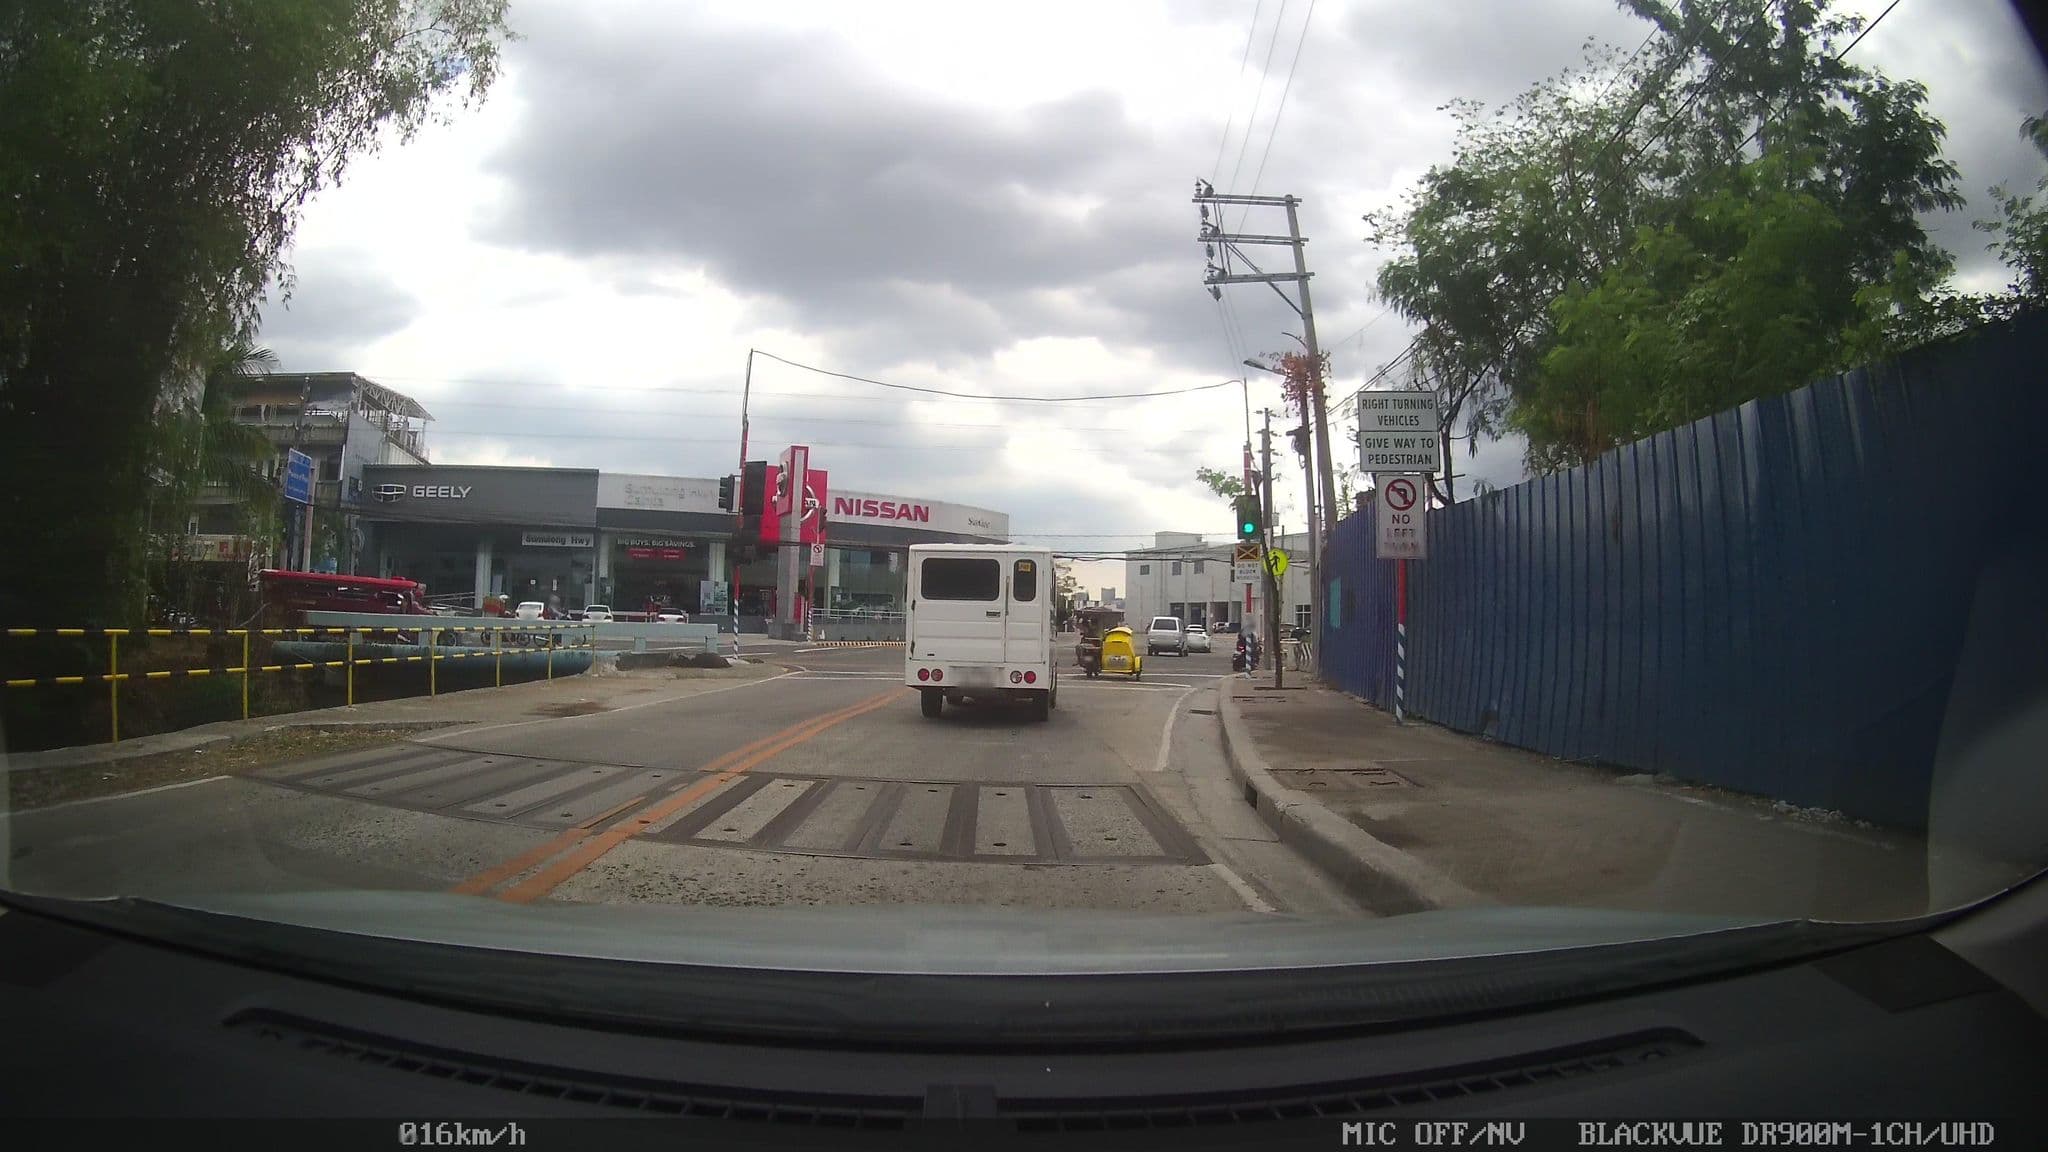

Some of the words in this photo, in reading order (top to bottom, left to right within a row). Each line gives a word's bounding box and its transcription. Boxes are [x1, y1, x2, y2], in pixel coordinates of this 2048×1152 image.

[1362, 398, 1389, 410] RIGHT
[1392, 398, 1434, 410] TURNING
[1377, 415, 1420, 426] VEHICLES
[1364, 437, 1390, 449] GIVE
[1393, 437, 1416, 449] WAY
[1420, 437, 1434, 449] TO
[1367, 453, 1433, 465] PEDESTRIAN
[412, 485, 472, 498] GEELY
[834, 496, 930, 522] NISSAN
[1391, 514, 1411, 525] NO
[571, 536, 591, 546] Hwy
